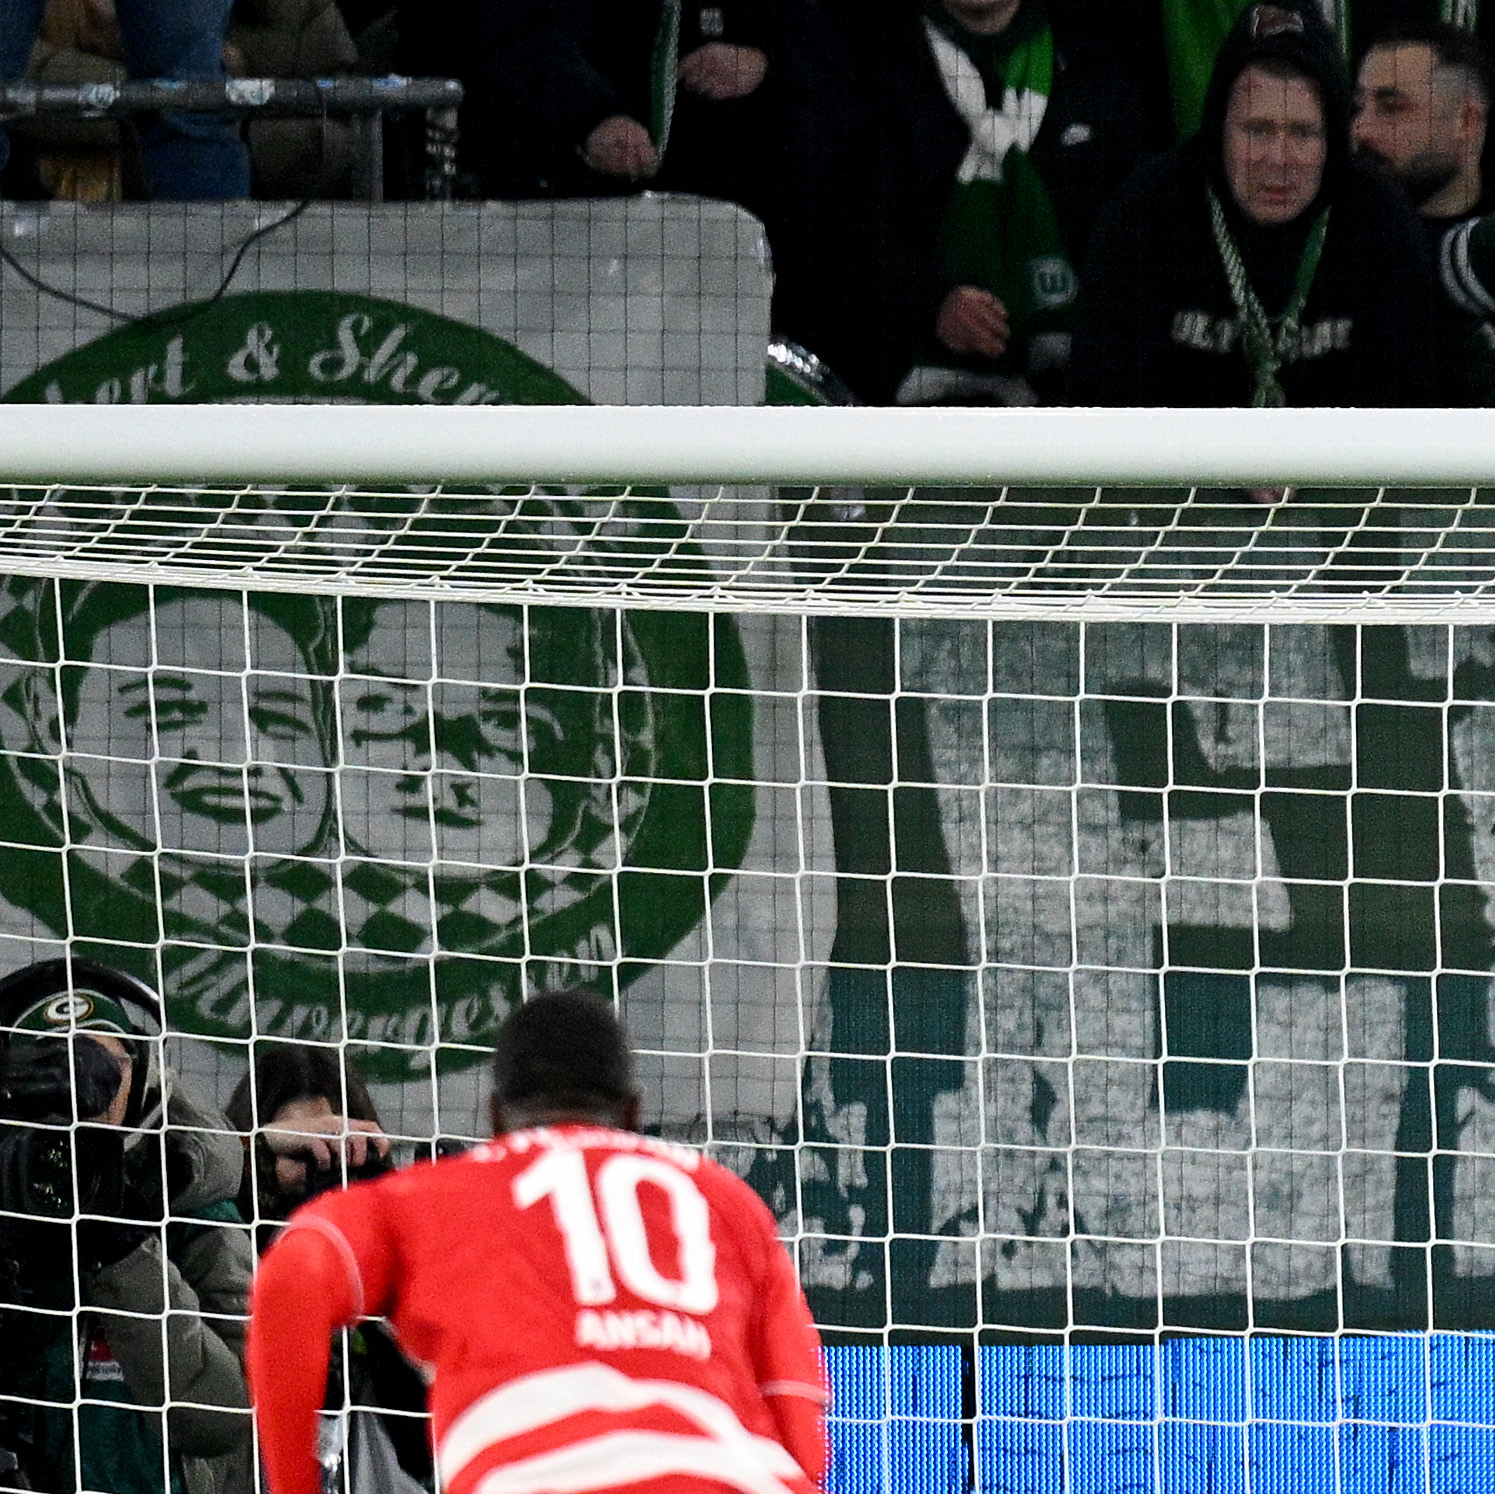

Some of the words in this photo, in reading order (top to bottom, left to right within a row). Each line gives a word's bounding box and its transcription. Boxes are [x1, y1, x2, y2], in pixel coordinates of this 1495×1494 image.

[227, 322, 280, 383] &
[164, 924, 617, 1068] Unvergesen
[511, 1146, 719, 1315] 10
[576, 1308, 712, 1361] ANSAH
